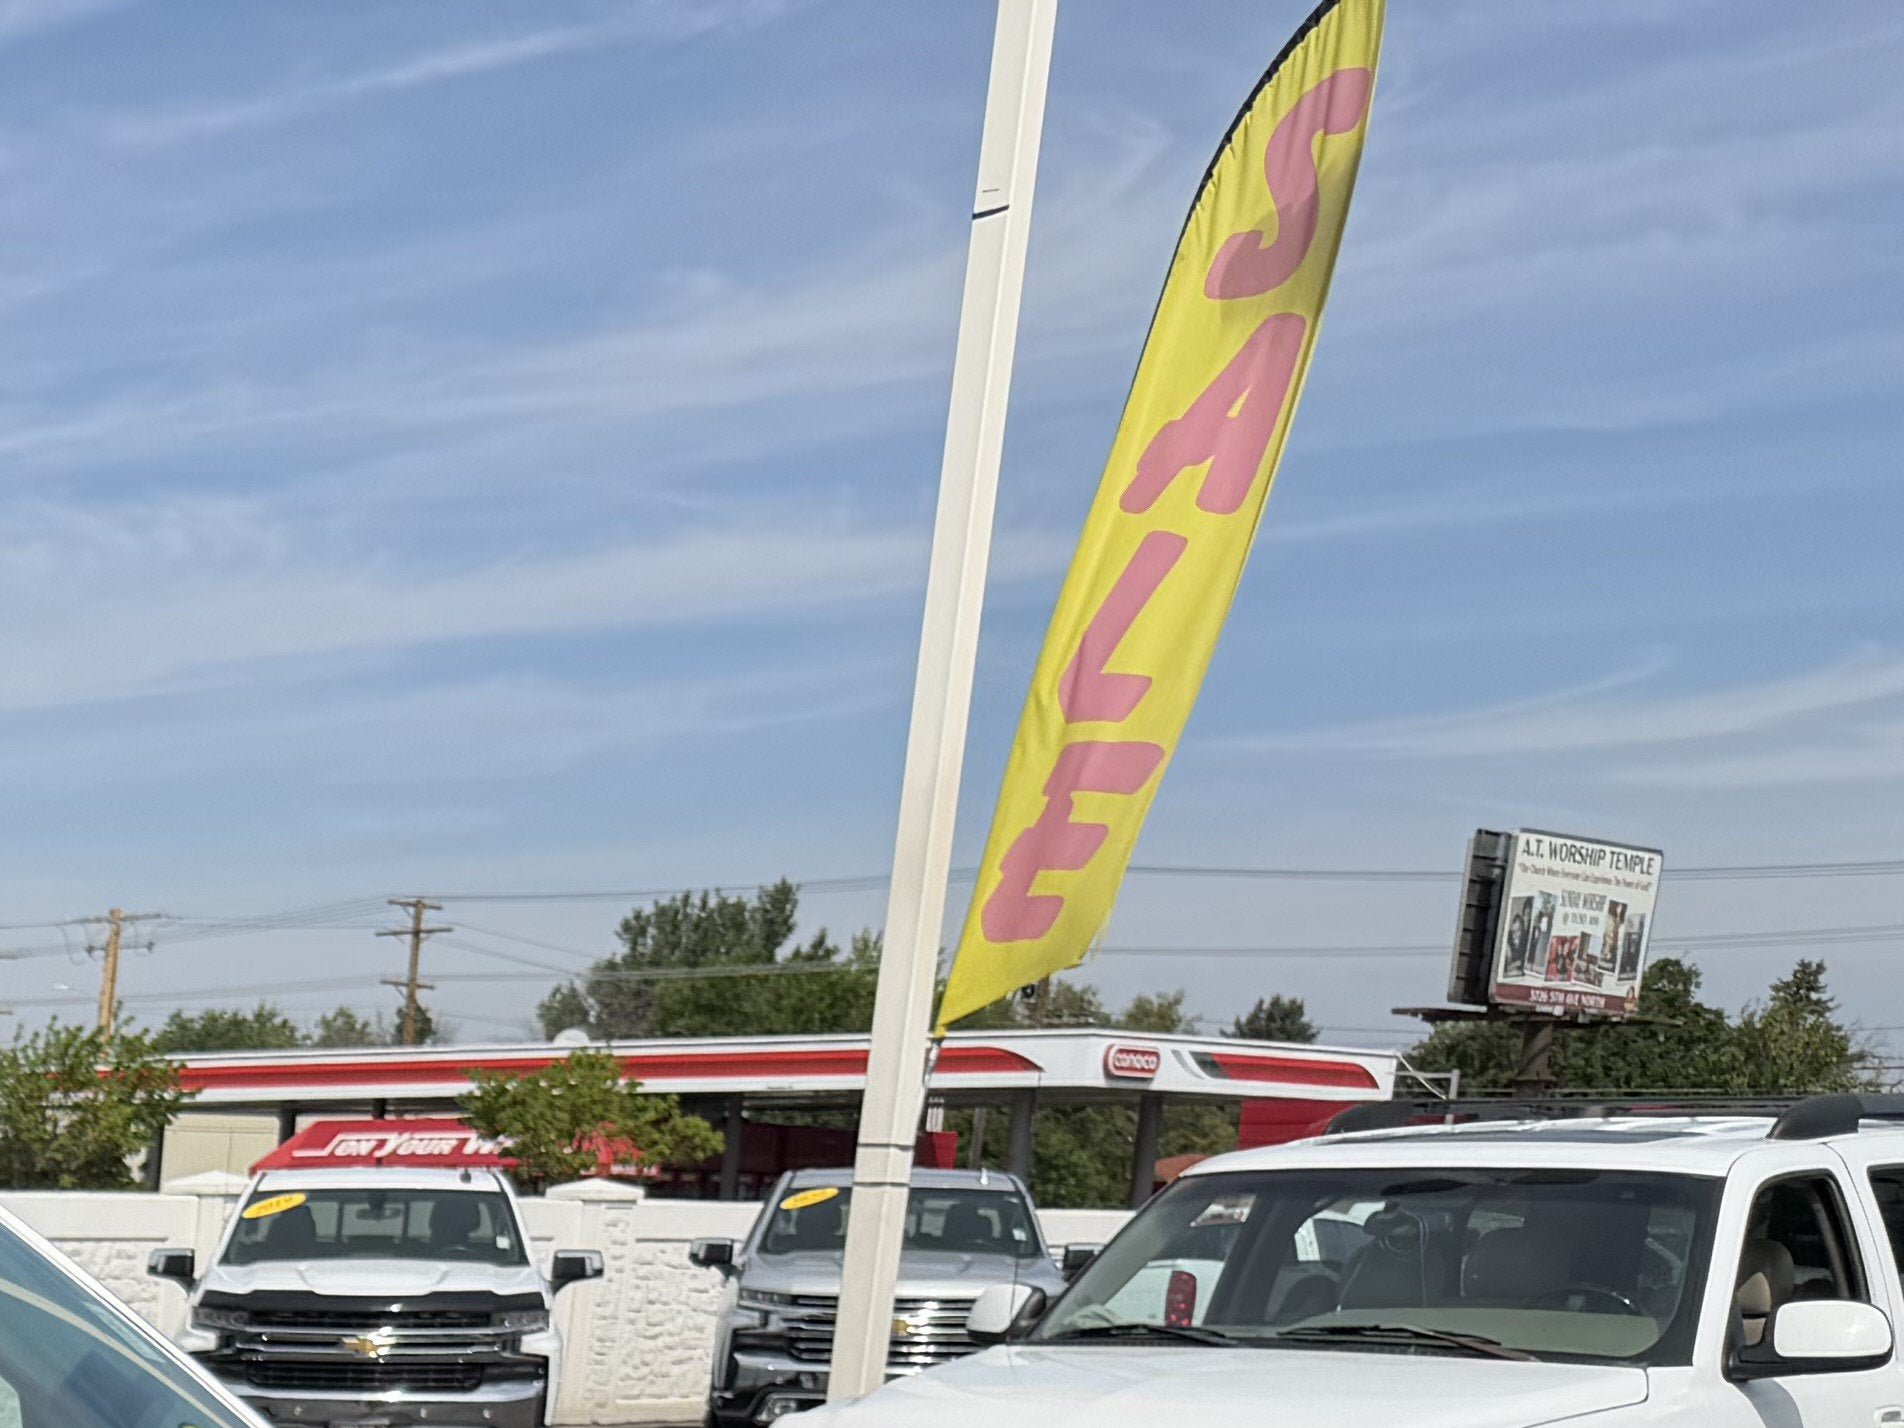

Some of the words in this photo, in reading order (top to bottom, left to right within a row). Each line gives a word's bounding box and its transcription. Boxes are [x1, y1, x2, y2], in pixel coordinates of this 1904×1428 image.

[980, 66, 1372, 944] SALE
[1522, 838, 1543, 859] A.T.
[1549, 841, 1606, 867] WORSHIP
[1609, 851, 1655, 875] TEMPLE
